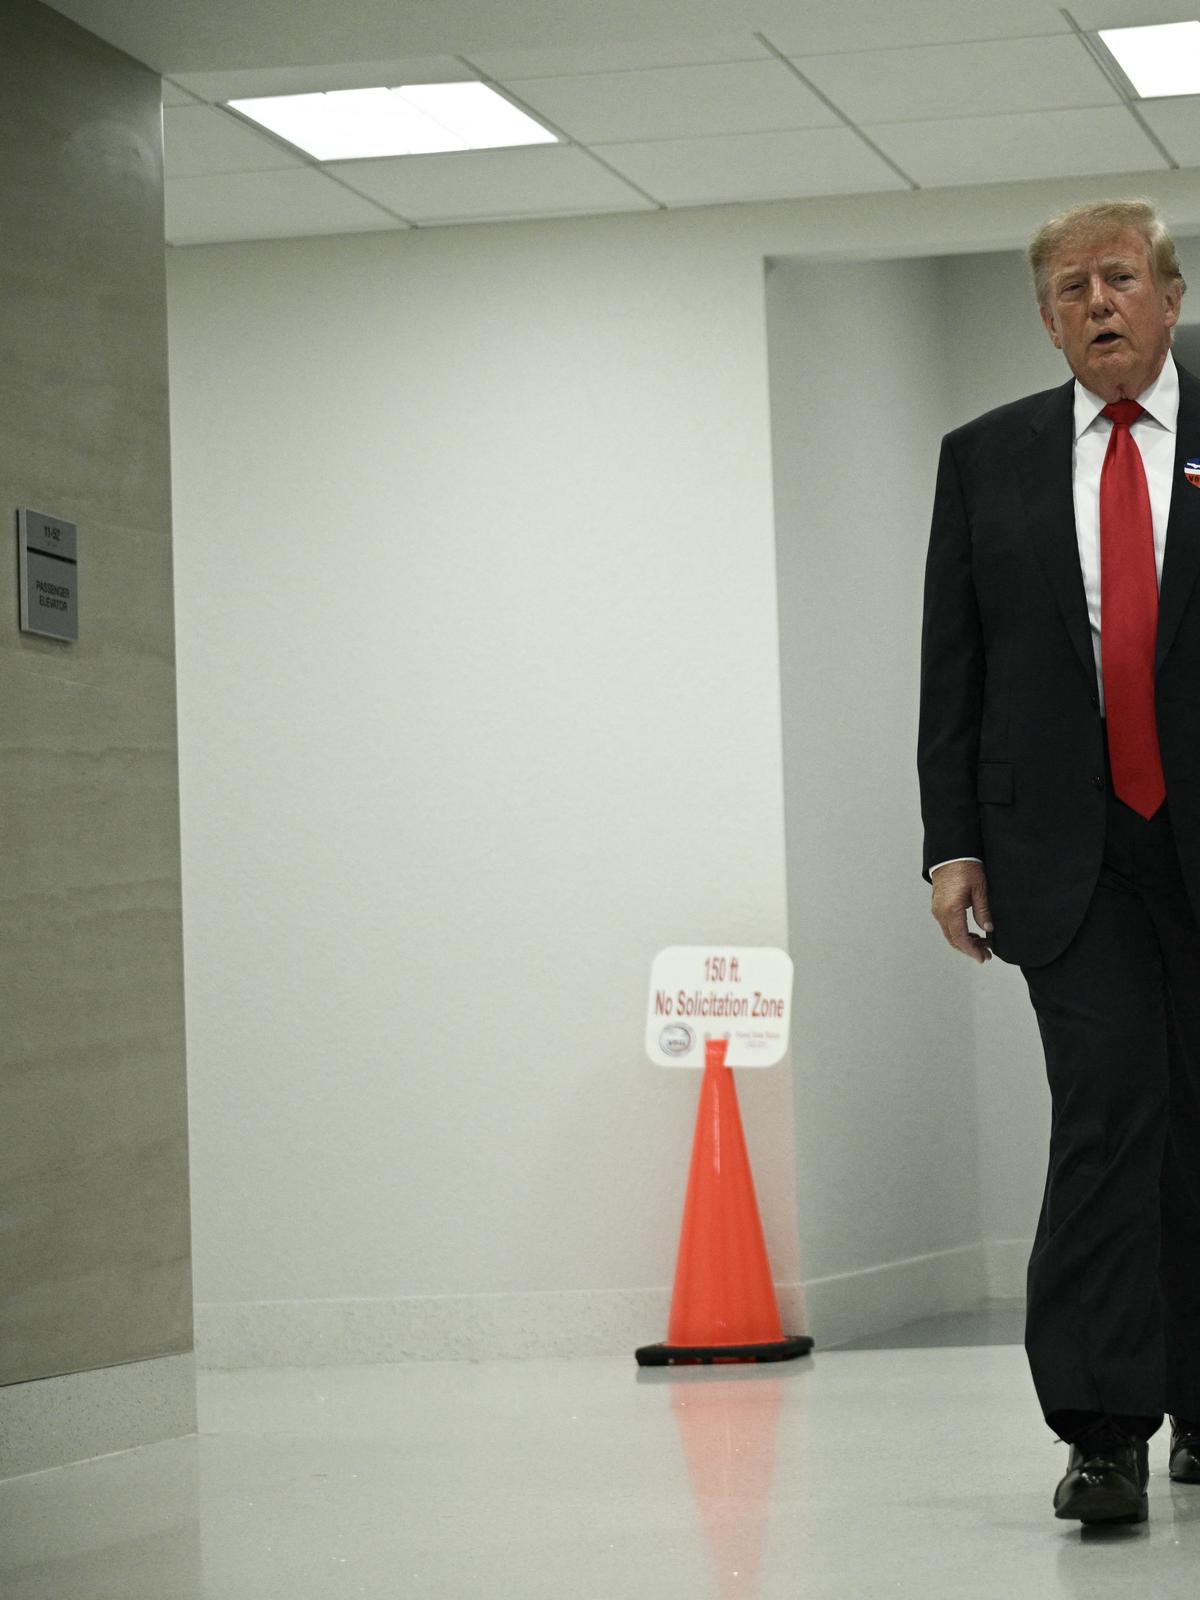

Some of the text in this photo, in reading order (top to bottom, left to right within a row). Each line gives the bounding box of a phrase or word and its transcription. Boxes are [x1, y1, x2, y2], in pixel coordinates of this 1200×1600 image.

[36, 580, 70, 599] PASSENGER
[39, 595, 68, 611] ELEVATOR
[704, 956, 742, 983] 150 ft.
[655, 989, 785, 1018] No Solicitation Zone
